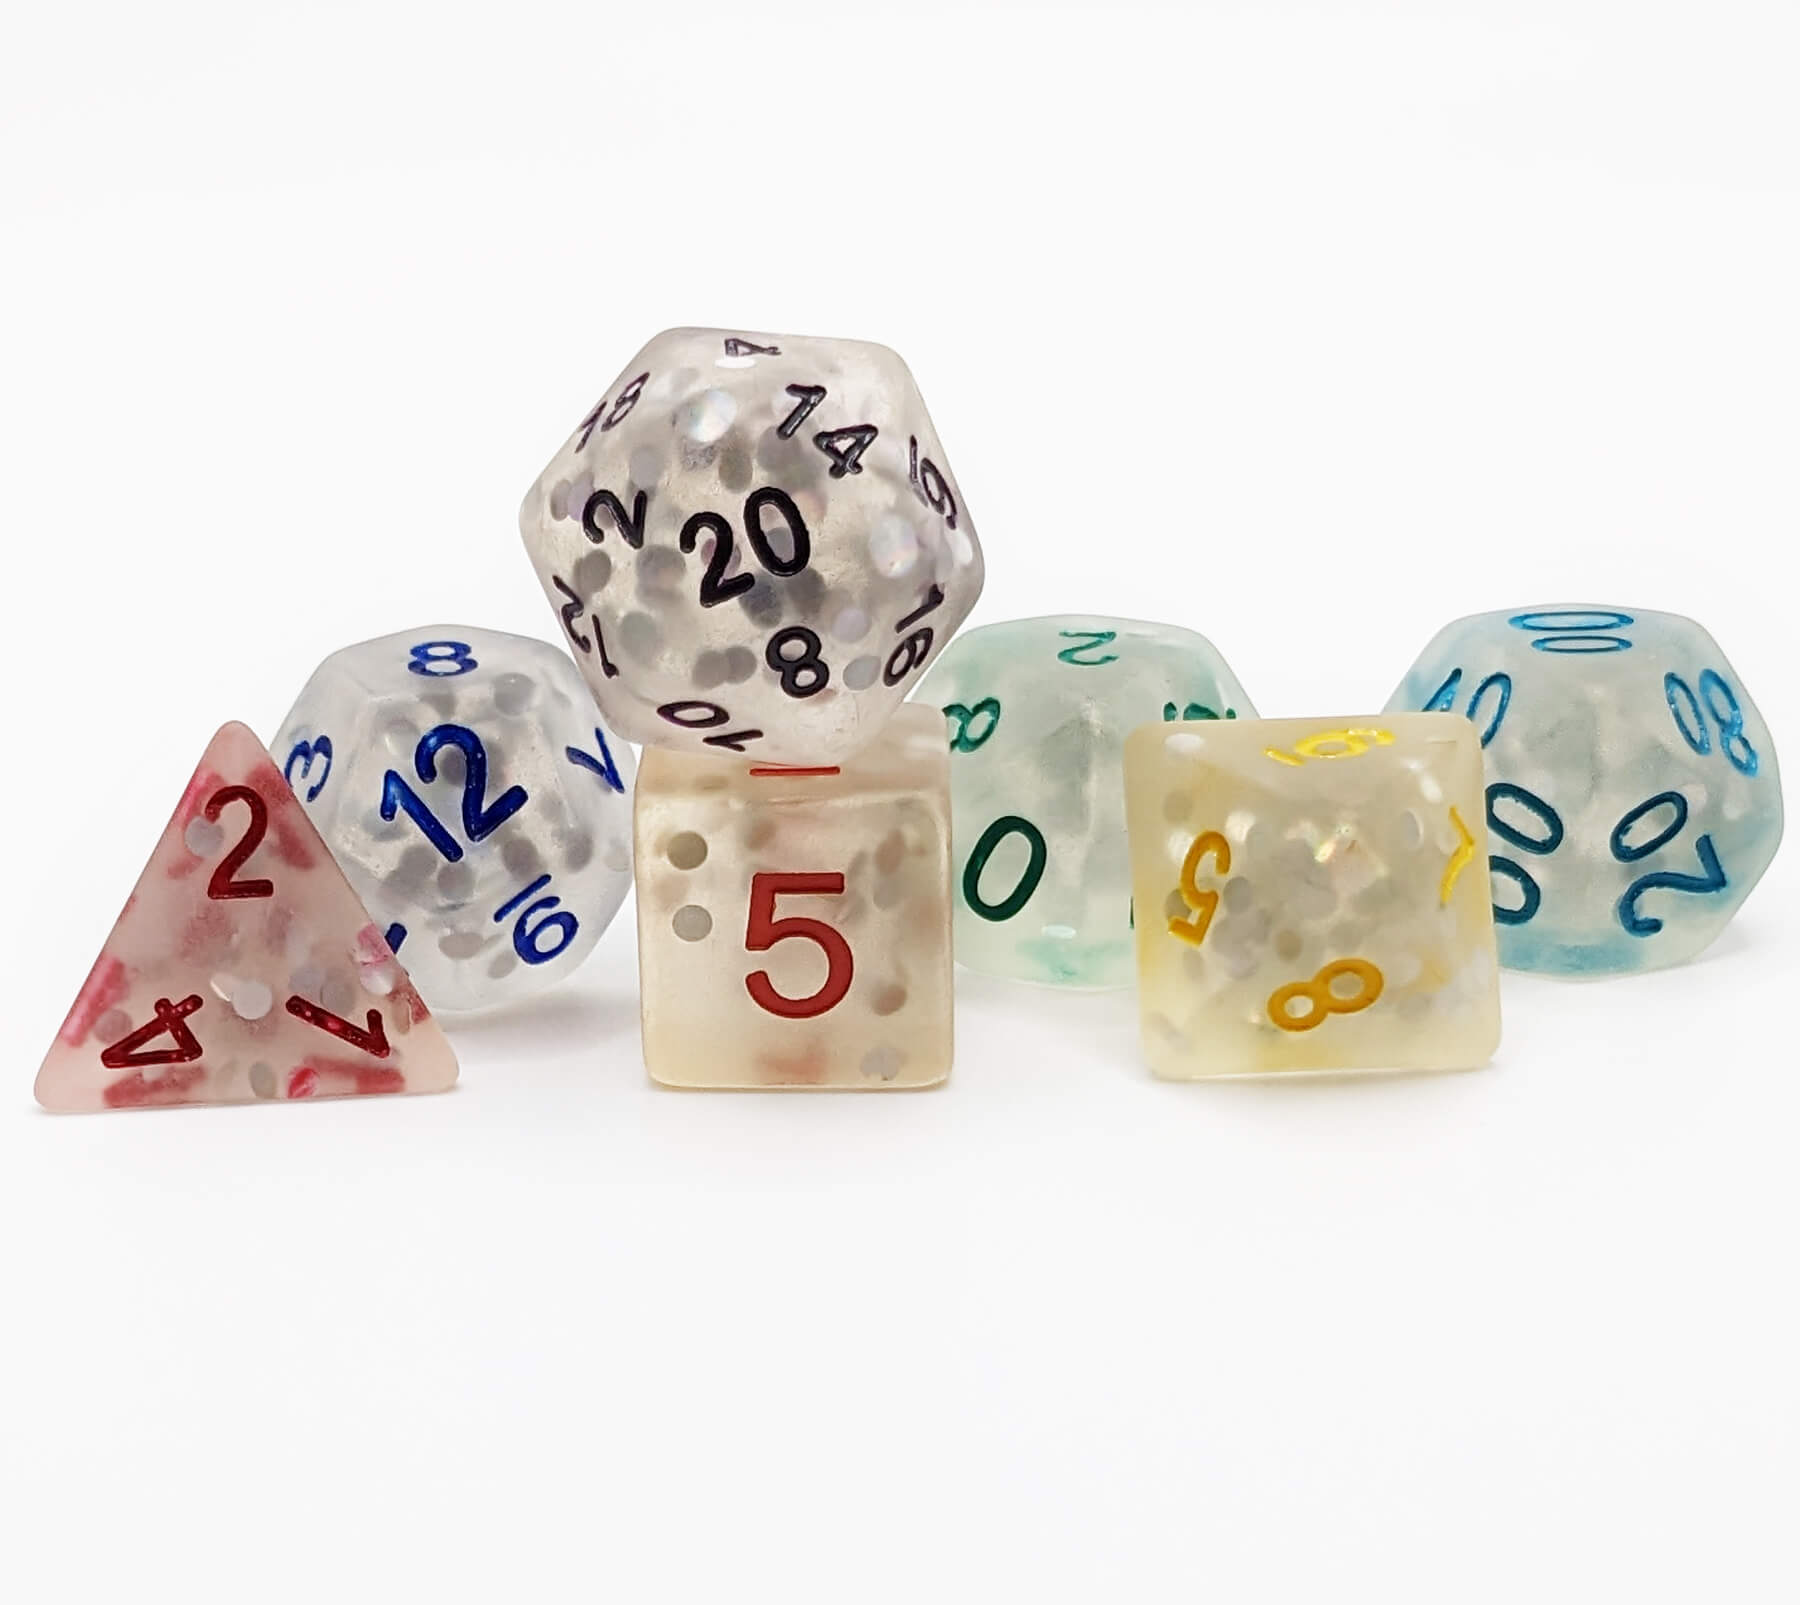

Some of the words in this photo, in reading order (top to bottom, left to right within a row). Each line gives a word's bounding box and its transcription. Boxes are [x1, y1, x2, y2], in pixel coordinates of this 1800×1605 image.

[575, 372, 650, 453] 18
[777, 383, 879, 479] 14
[582, 489, 648, 550] 2
[679, 486, 811, 609] 20
[409, 641, 478, 676] 8
[765, 626, 830, 699] 8
[883, 583, 945, 687] 16
[1057, 631, 1120, 666] 2
[656, 700, 764, 753] 10
[284, 734, 333, 802] 3
[380, 723, 529, 862] 12
[203, 784, 275, 900] 2
[962, 815, 1048, 923] 0
[1608, 791, 1728, 938] 20
[1167, 830, 1233, 947] 5
[744, 871, 855, 1020] 5
[100, 994, 204, 1069] 4
[285, 994, 391, 1059] 1
[1266, 958, 1384, 1033] 8
